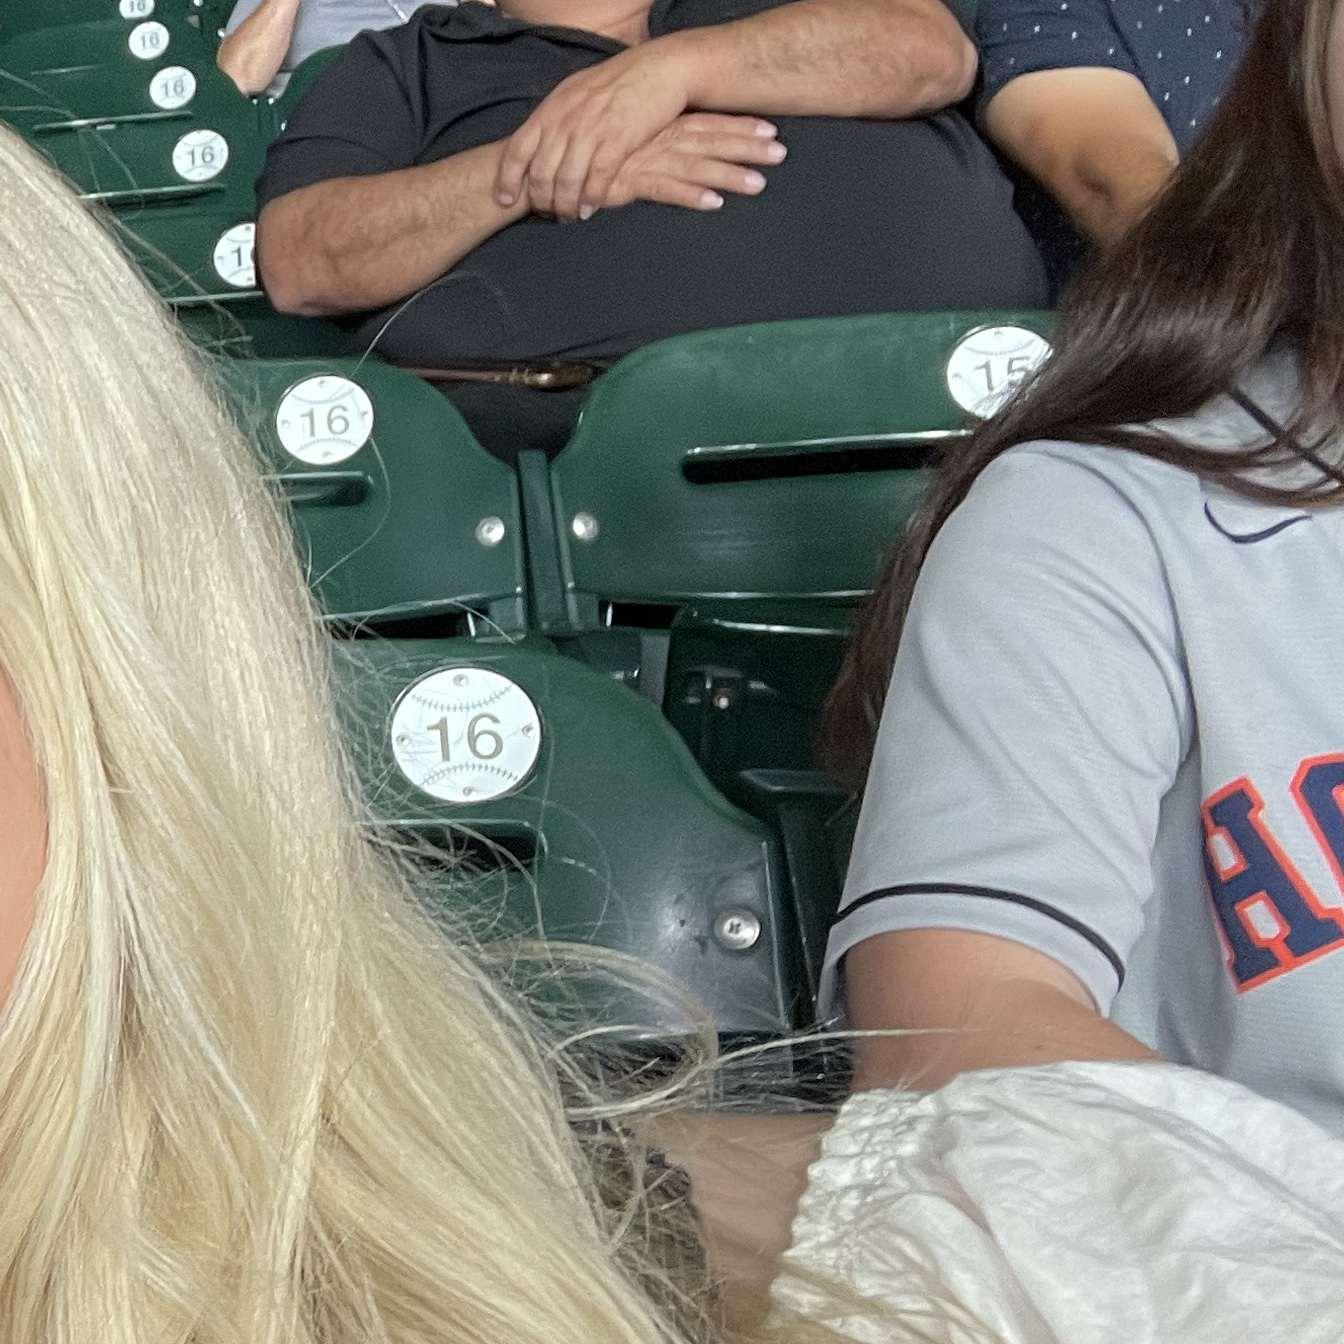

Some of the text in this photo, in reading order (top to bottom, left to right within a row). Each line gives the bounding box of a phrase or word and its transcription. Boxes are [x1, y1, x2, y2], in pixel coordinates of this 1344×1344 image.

[141, 31, 160, 50] 16
[162, 78, 185, 99] 16
[186, 145, 215, 167] 16
[231, 245, 255, 267] 1
[974, 356, 1032, 394] 15
[299, 404, 351, 439] 16
[425, 712, 505, 764] 16
